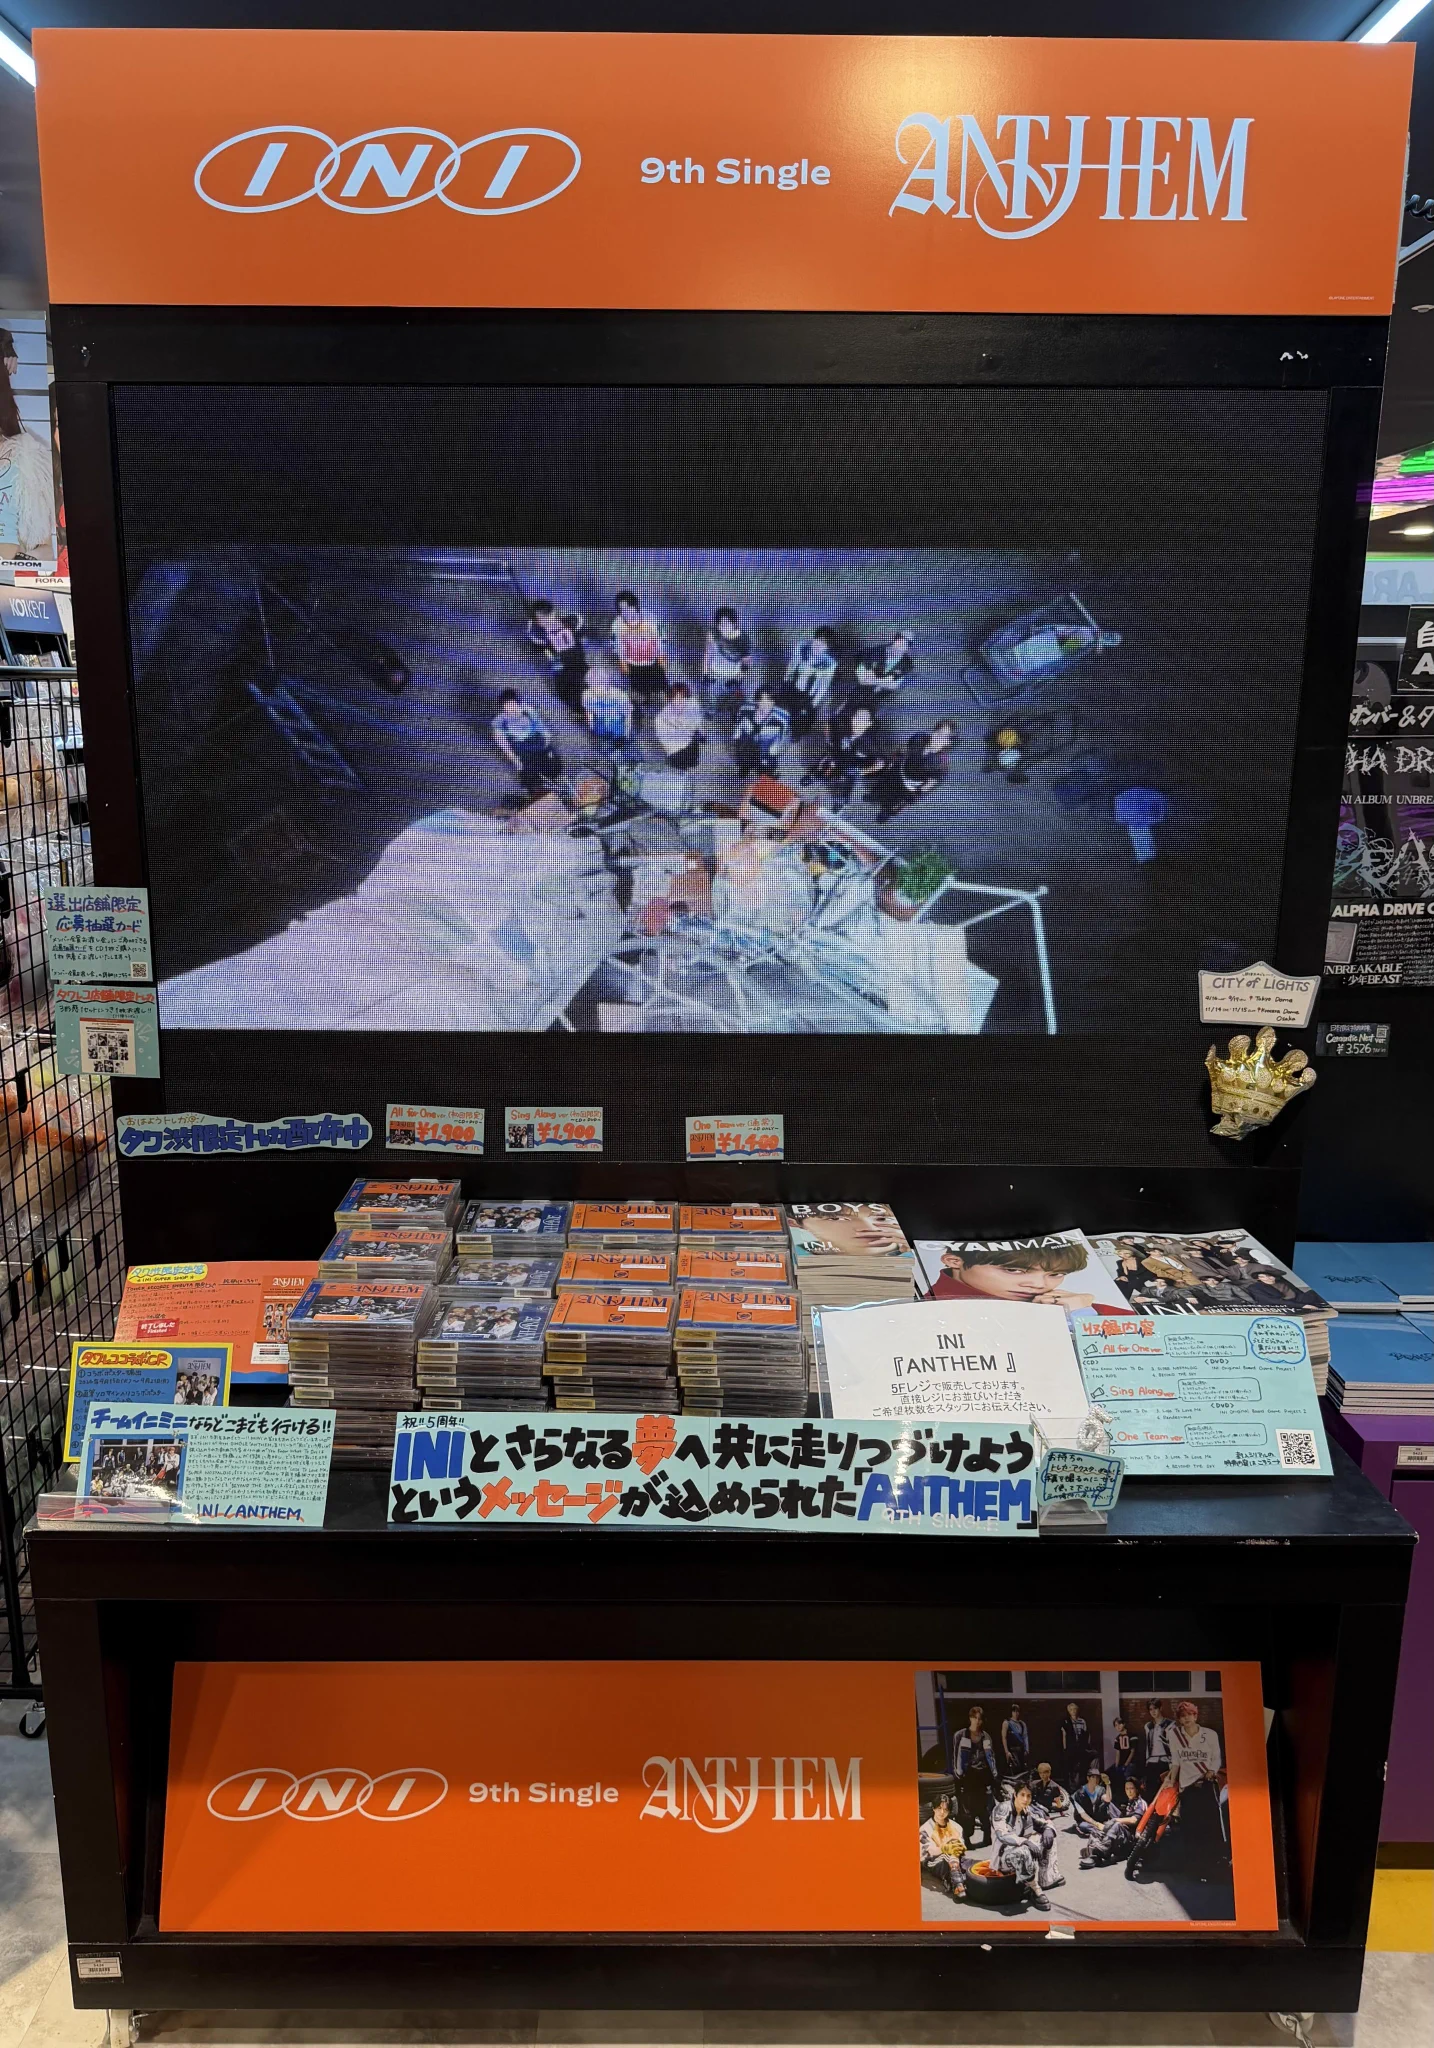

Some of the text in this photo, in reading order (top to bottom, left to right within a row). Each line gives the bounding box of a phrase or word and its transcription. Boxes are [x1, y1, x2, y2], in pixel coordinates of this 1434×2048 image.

[241, 111, 1256, 241] INI 9th Single ANTHEM
[1353, 795, 1392, 805] ALBUM
[1331, 903, 1380, 918] ALPHA
[1382, 902, 1425, 916] DRIVE
[1212, 976, 1311, 992] CITY of LIGHTS
[390, 1106, 403, 1118] All
[406, 1108, 418, 1119] for
[419, 1109, 437, 1119] One
[510, 1109, 531, 1121] Sing
[533, 1109, 556, 1119] Along
[693, 1119, 711, 1131] One
[120, 1114, 369, 1155] タワ渋限定トレカ配布中
[589, 1204, 669, 1215] ANTHEM
[695, 1207, 775, 1217] ANTHEM
[791, 1203, 888, 1215] BOYS
[803, 1241, 834, 1250] INI
[578, 1253, 666, 1265] ANTHEM
[694, 1251, 780, 1263] ANTHEM
[575, 1294, 668, 1307] ANTHEM
[699, 1291, 791, 1305] ANTHEM
[1082, 1319, 1155, 1338] 収録内容
[936, 1334, 966, 1350] INI
[1102, 1344, 1115, 1354] All
[1117, 1343, 1130, 1353] for
[1131, 1343, 1150, 1353] One
[890, 1380, 1025, 1396] 5Fレジで販売しております。
[1109, 1385, 1135, 1397] Sing
[1138, 1386, 1164, 1397] Along
[900, 1391, 1022, 1405] 直接レジにお並びいただき
[872, 1401, 1053, 1417] ご希望枚数をスタッフにお伝えください。
[90, 1407, 333, 1437] チームイニミニならどこまでも行ける!!
[1116, 1431, 1139, 1442] One
[1142, 1431, 1169, 1440] Team
[393, 1415, 1035, 1482] INIとさらなる夢へ共に走りつづけよう
[931, 1512, 999, 1533] SINGLE
[1118, 1735, 1130, 1750] 10
[235, 1755, 866, 1834] INI 9th Single ANTHEM
